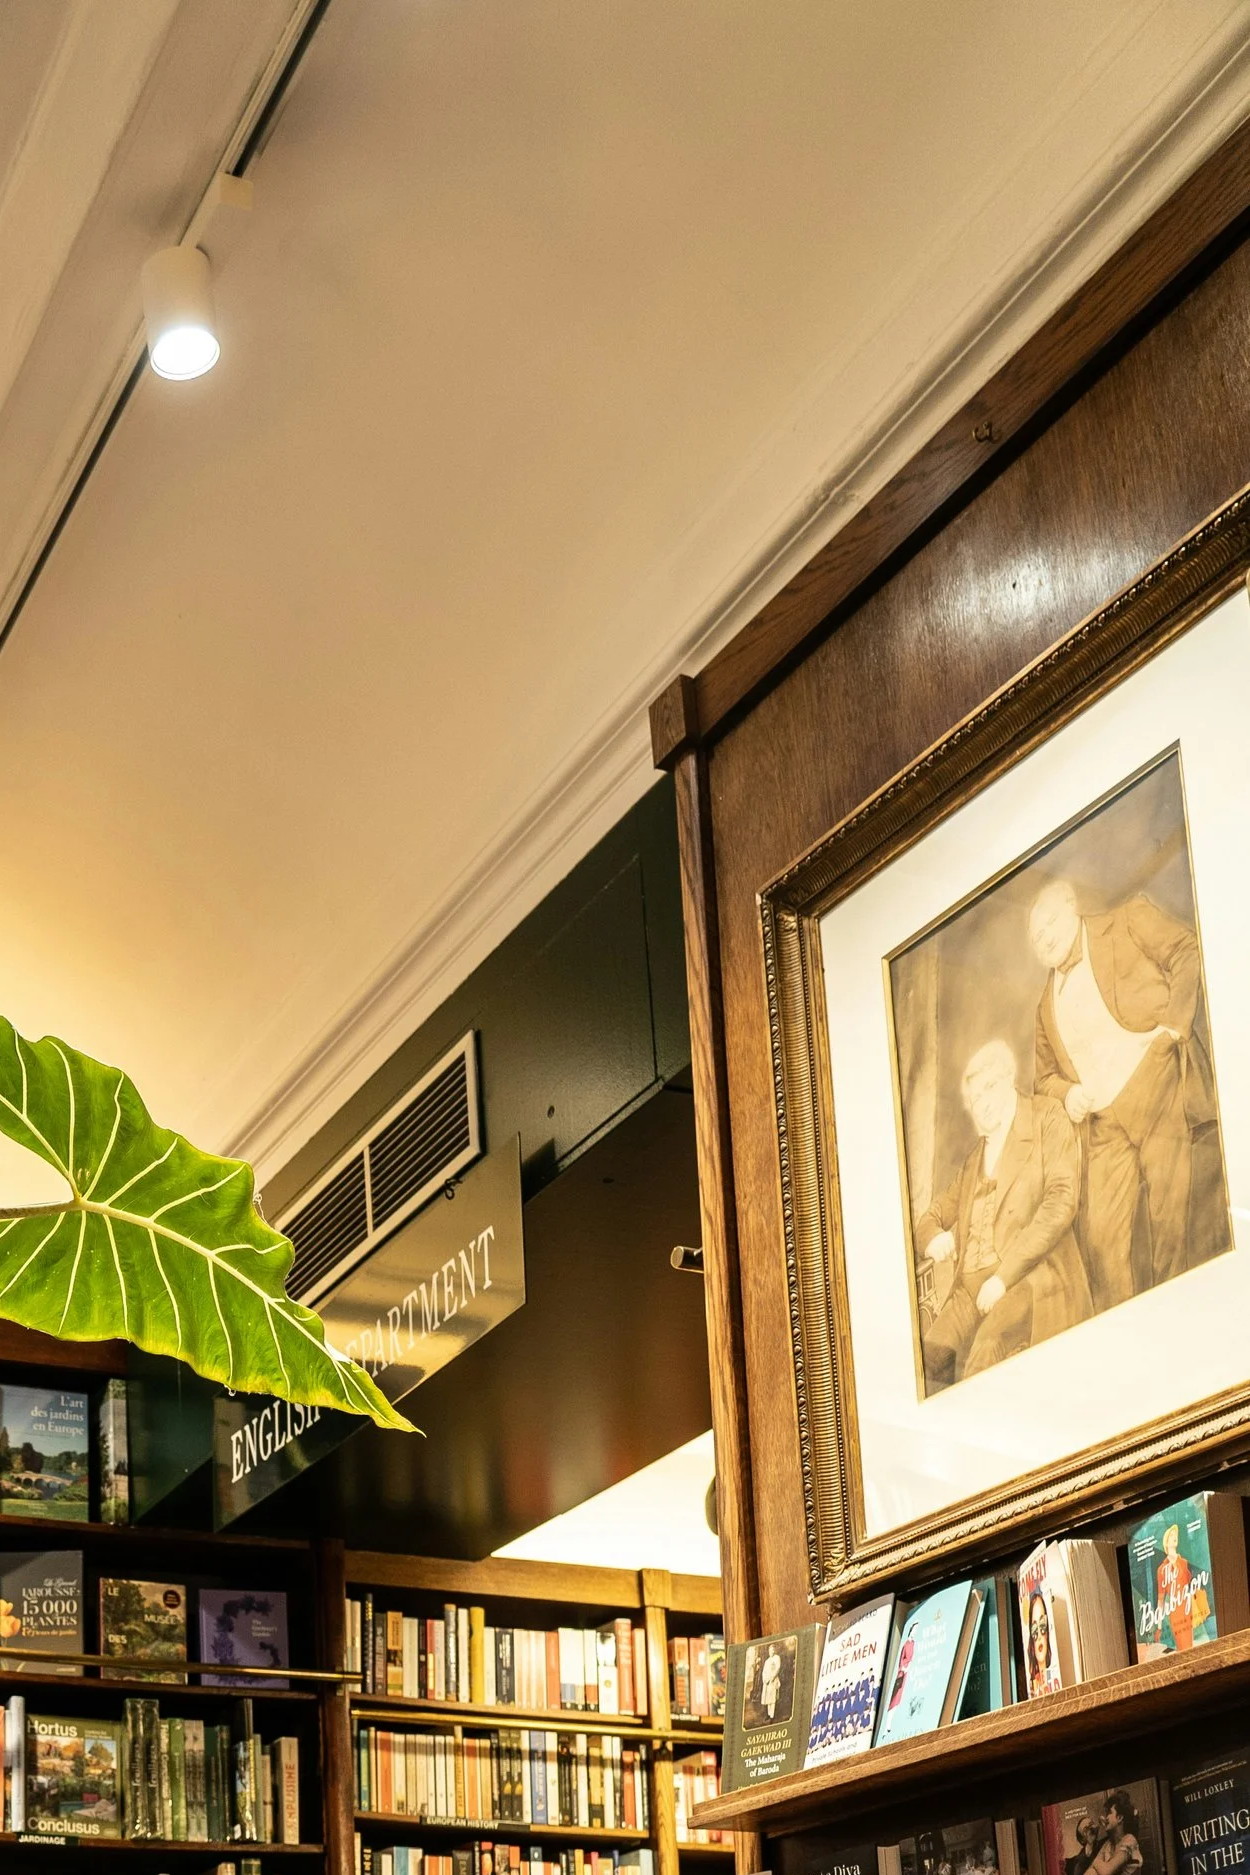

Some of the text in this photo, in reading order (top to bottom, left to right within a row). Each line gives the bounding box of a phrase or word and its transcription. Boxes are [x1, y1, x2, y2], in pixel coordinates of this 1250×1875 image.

[342, 1226, 495, 1378] EPARTMENT
[60, 1396, 83, 1408] L'art
[31, 1407, 84, 1421] des jardins
[33, 1422, 84, 1437] en Europe
[230, 1401, 321, 1484] ENGLISH
[1161, 1561, 1179, 1589] The
[22, 1600, 77, 1615] 15 000
[1139, 1570, 1209, 1636] Barbizon
[22, 1615, 77, 1627] PLANTES
[108, 1634, 127, 1645] DES
[840, 1633, 861, 1649] SAD
[821, 1642, 877, 1678] LITTLE MEN
[28, 1720, 77, 1737] Hortus
[746, 1728, 788, 1745] SAYAJIRAO
[745, 1752, 786, 1768] The Maharaja
[1184, 1779, 1235, 1804] WILL LOXLEY
[28, 1817, 100, 1834] Conclusus
[426, 1816, 499, 1830] EUROPEAN HISTORY
[1180, 1809, 1250, 1848] WRITING
[19, 1835, 66, 1845] JARDINAGE
[1210, 1842, 1245, 1870] THE
